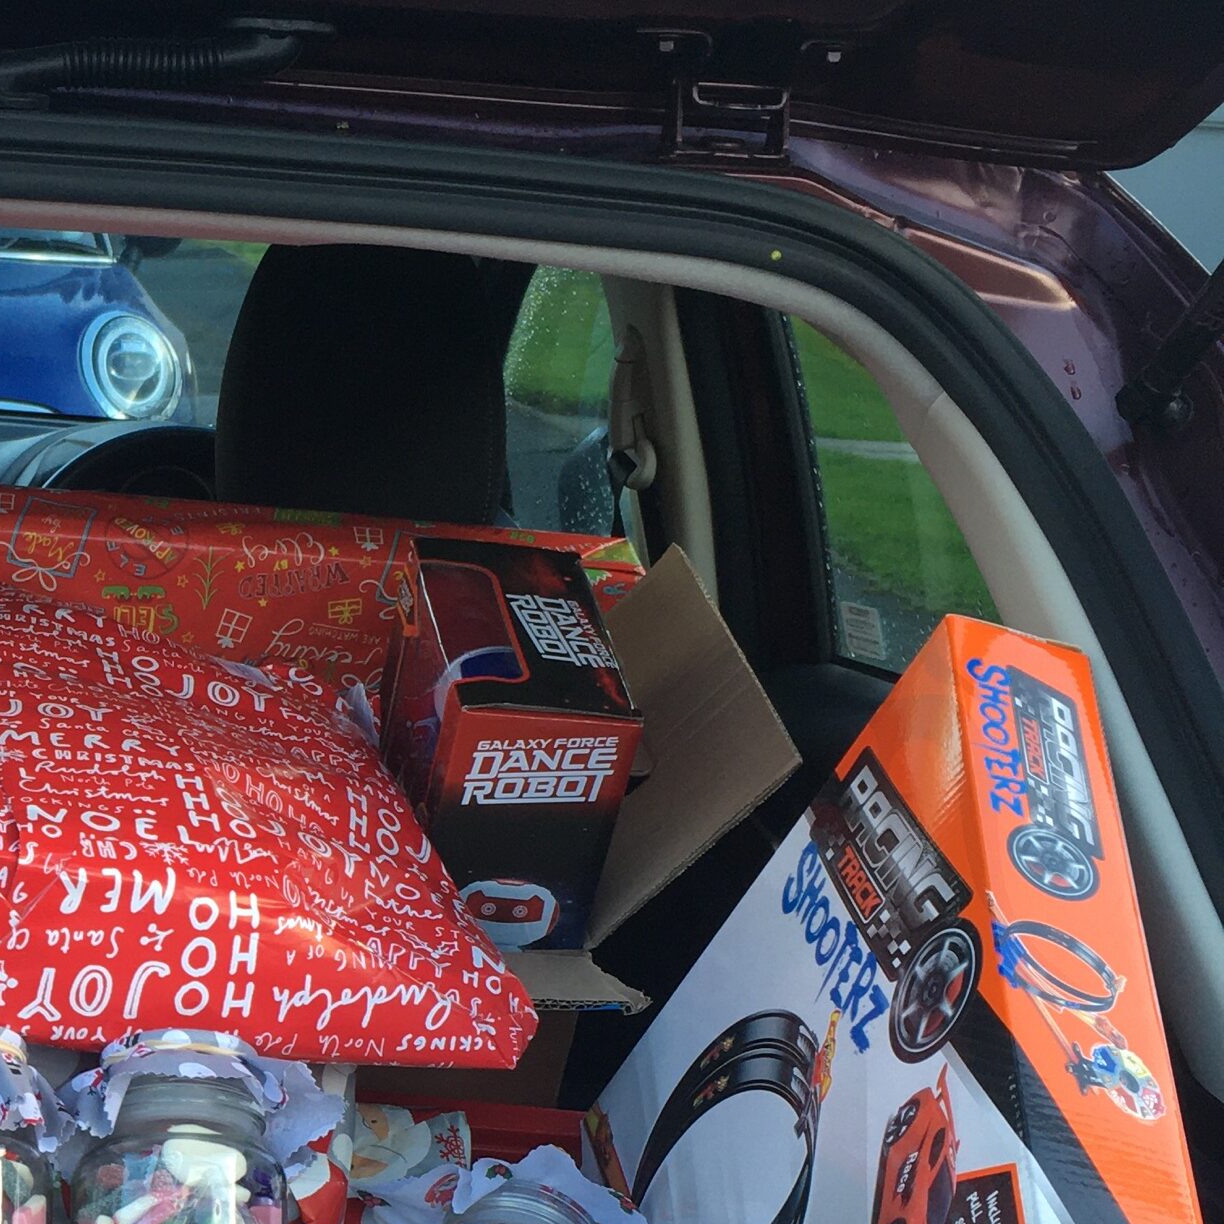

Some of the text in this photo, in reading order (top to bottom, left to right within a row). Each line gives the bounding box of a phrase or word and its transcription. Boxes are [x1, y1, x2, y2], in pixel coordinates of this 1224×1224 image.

[506, 593, 586, 669] ROBOT
[533, 594, 606, 669] DANCE
[164, 673, 276, 713] JOY
[477, 736, 619, 751] GALAXY FORCE
[965, 657, 1030, 818] SHOOTERZ
[31, 747, 196, 773] CHRISTMAS
[465, 748, 618, 780] DANCE
[1039, 696, 1096, 847] RACING
[18, 778, 171, 809] Christmas
[461, 769, 615, 806] ROBOT
[845, 765, 957, 923] RACING
[836, 845, 884, 918] TRACK
[188, 889, 261, 931] HO
[44, 926, 125, 959] Santa
[180, 931, 260, 978] HO
[781, 840, 891, 1054] SHOOTERZ
[16, 960, 172, 1022] JOY
[173, 979, 256, 1018] HO
[272, 974, 453, 1032] Rudolph
[966, 1191, 979, 1224] PULL
